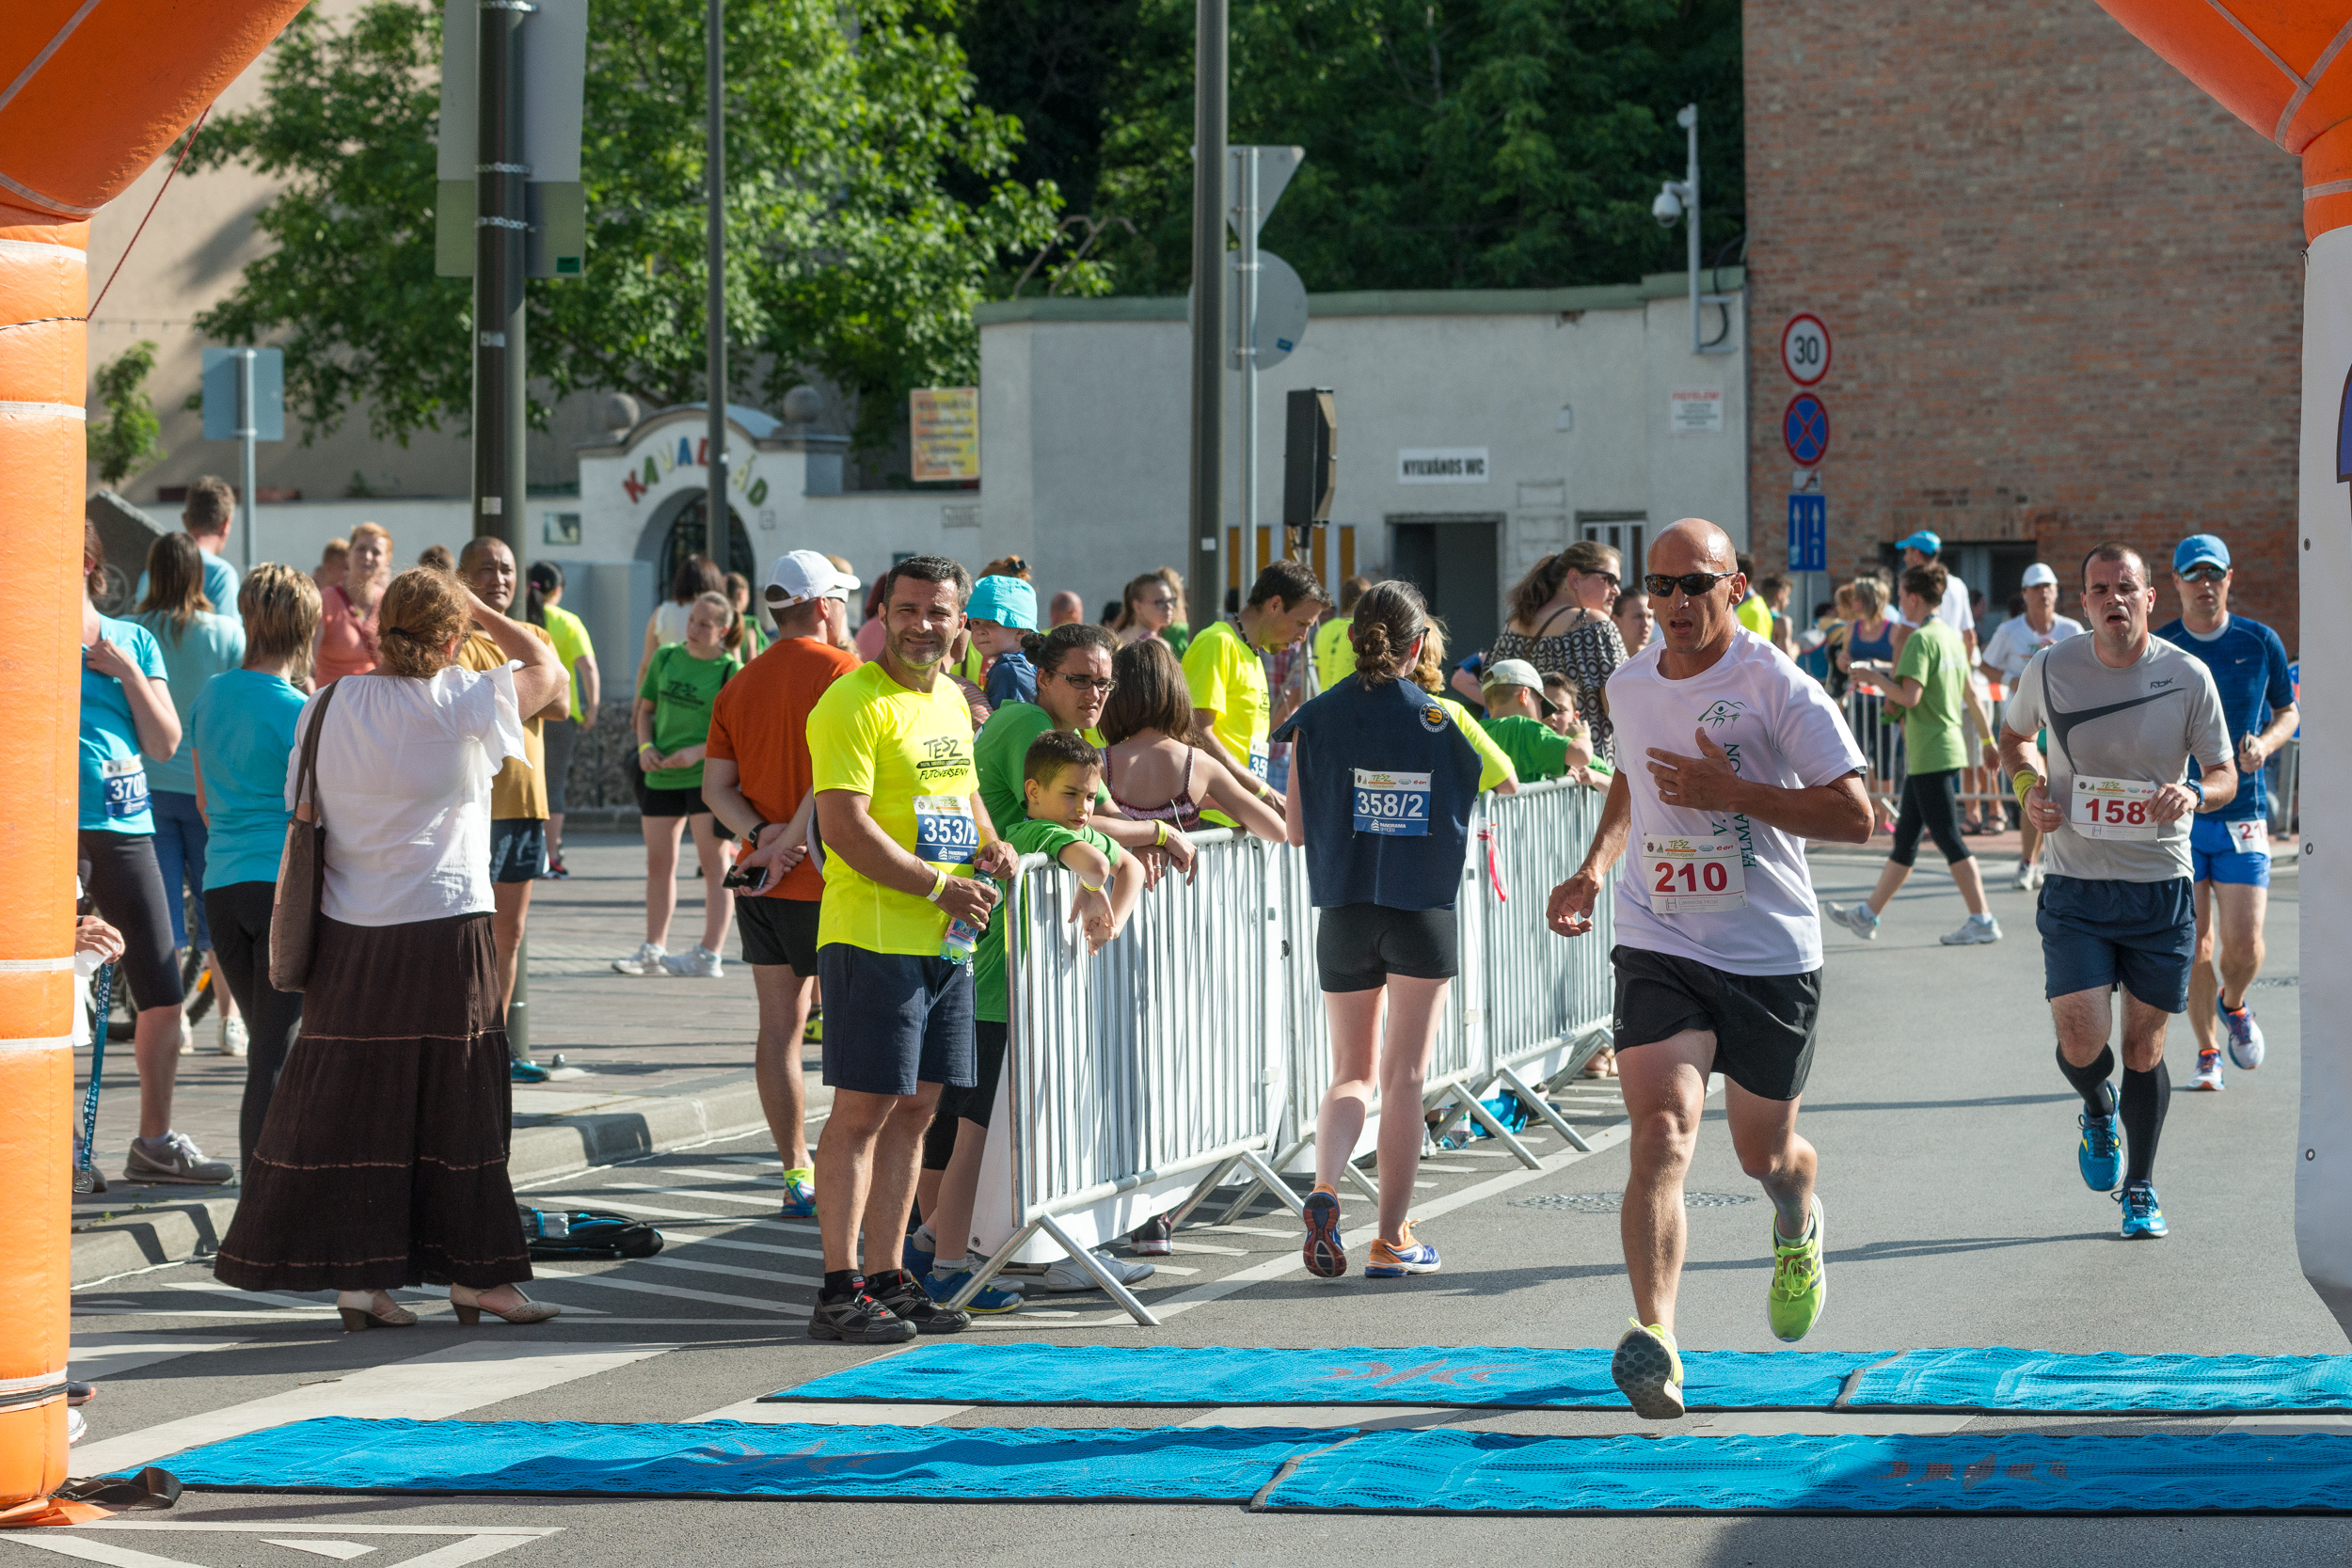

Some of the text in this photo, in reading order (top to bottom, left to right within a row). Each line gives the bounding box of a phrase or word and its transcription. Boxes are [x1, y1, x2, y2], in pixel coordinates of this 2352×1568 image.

[1794, 336, 1820, 365] 30
[1403, 457, 1485, 476] NYILVÁNOS WC
[923, 736, 963, 759] TESZ
[1358, 791, 1423, 817] 358/2
[2085, 798, 2146, 825] 158
[924, 817, 977, 845] 353/2
[1668, 839, 1692, 849] TESZ
[1655, 863, 1728, 893] 210
